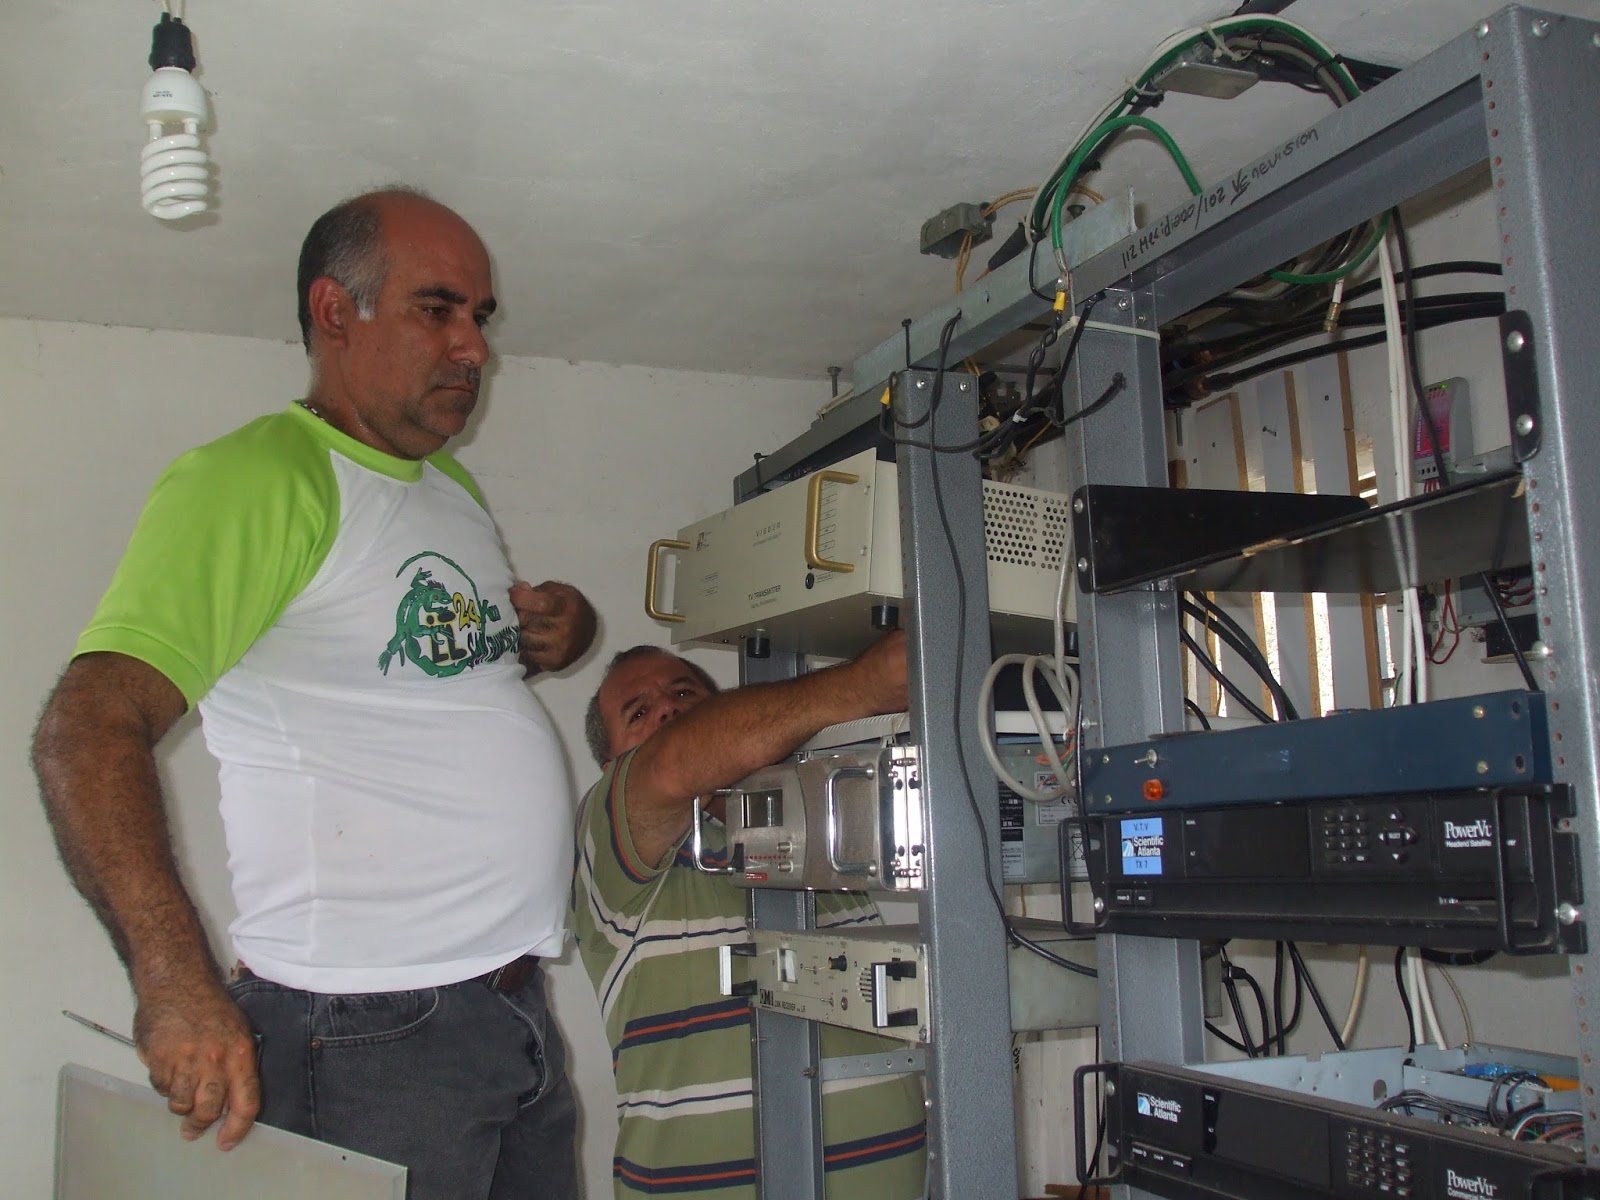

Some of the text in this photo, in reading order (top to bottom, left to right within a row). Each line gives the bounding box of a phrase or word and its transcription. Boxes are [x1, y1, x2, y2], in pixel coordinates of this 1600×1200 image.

[1122, 244, 1137, 269] 112
[1133, 835, 1164, 848] Scientific
[1137, 847, 1161, 857] Atlanta
[1150, 1095, 1181, 1113] Scientific
[1154, 1107, 1178, 1123] Atlanta
[1447, 1169, 1494, 1197] PowerVu
